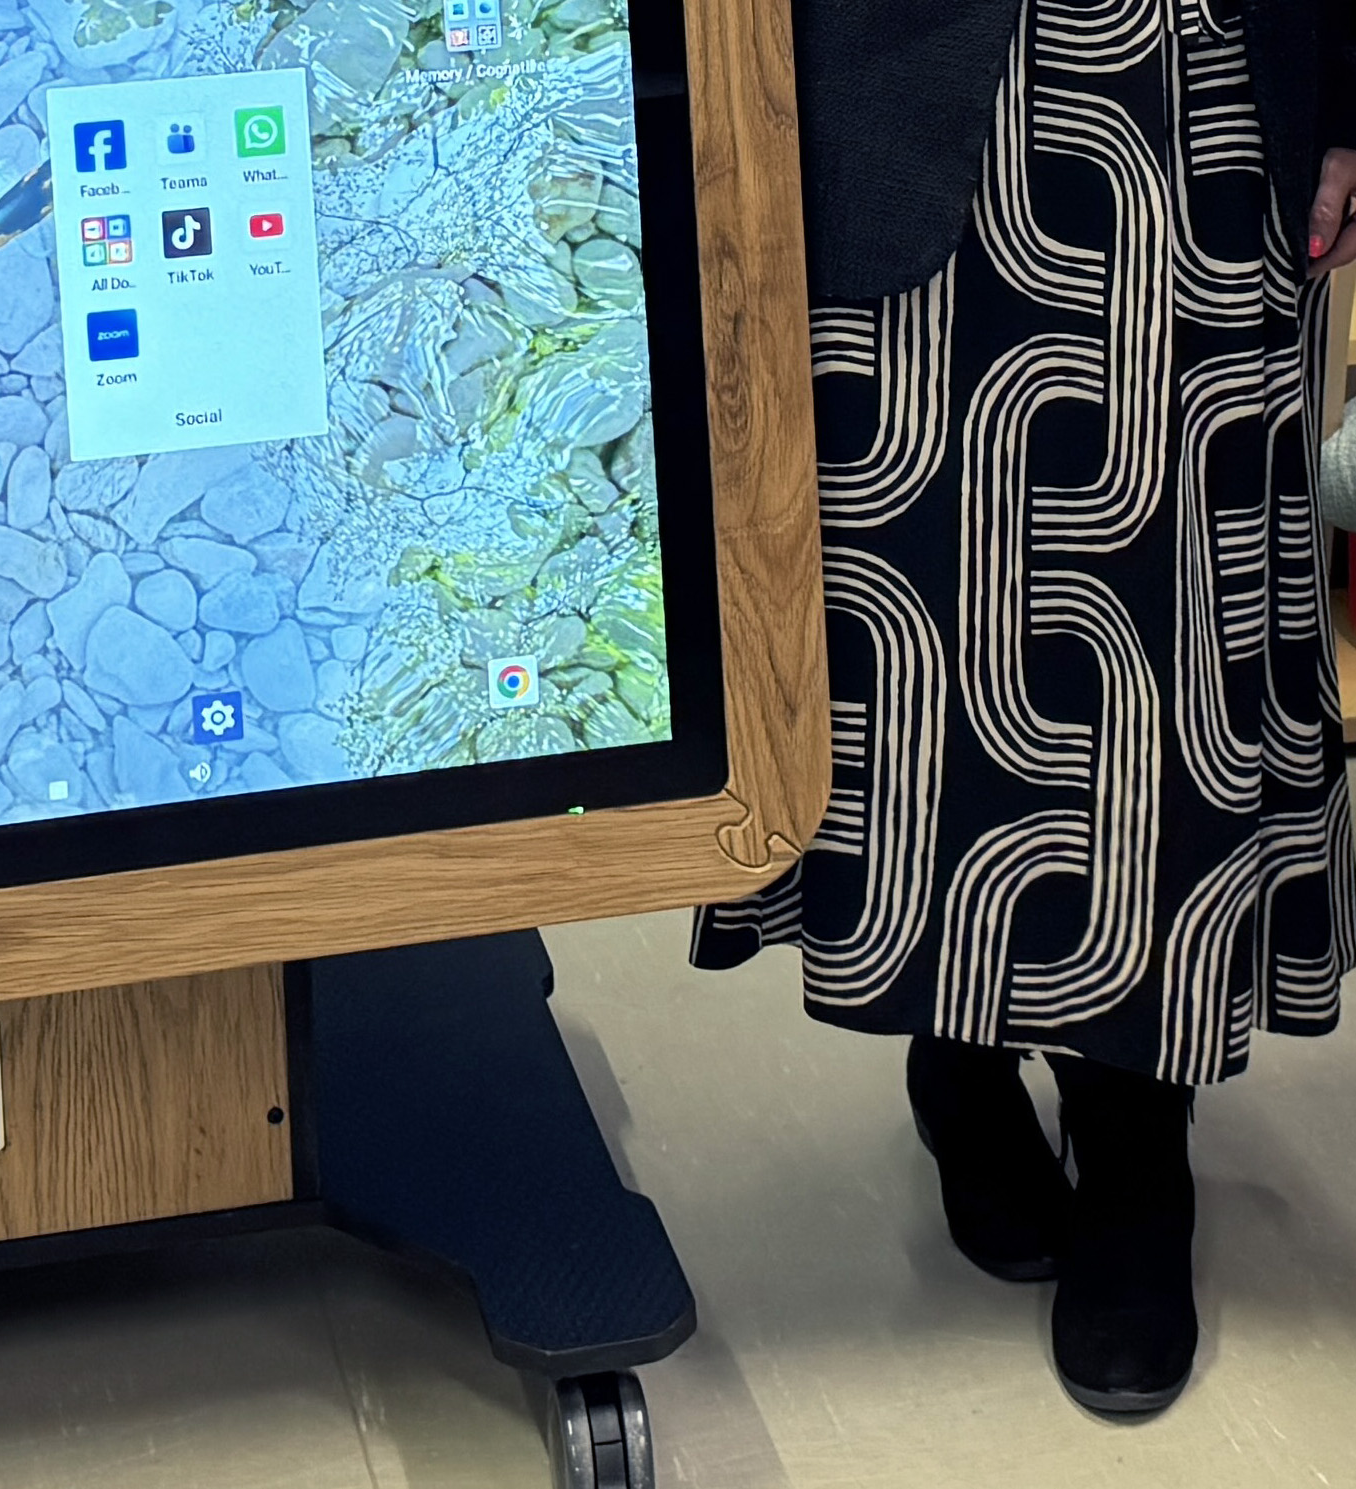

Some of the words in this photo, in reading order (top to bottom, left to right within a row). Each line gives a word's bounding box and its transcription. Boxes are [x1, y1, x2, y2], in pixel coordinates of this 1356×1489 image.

[405, 66, 463, 84] Memory
[96, 371, 138, 387] Zoom
[175, 409, 223, 427] Social
